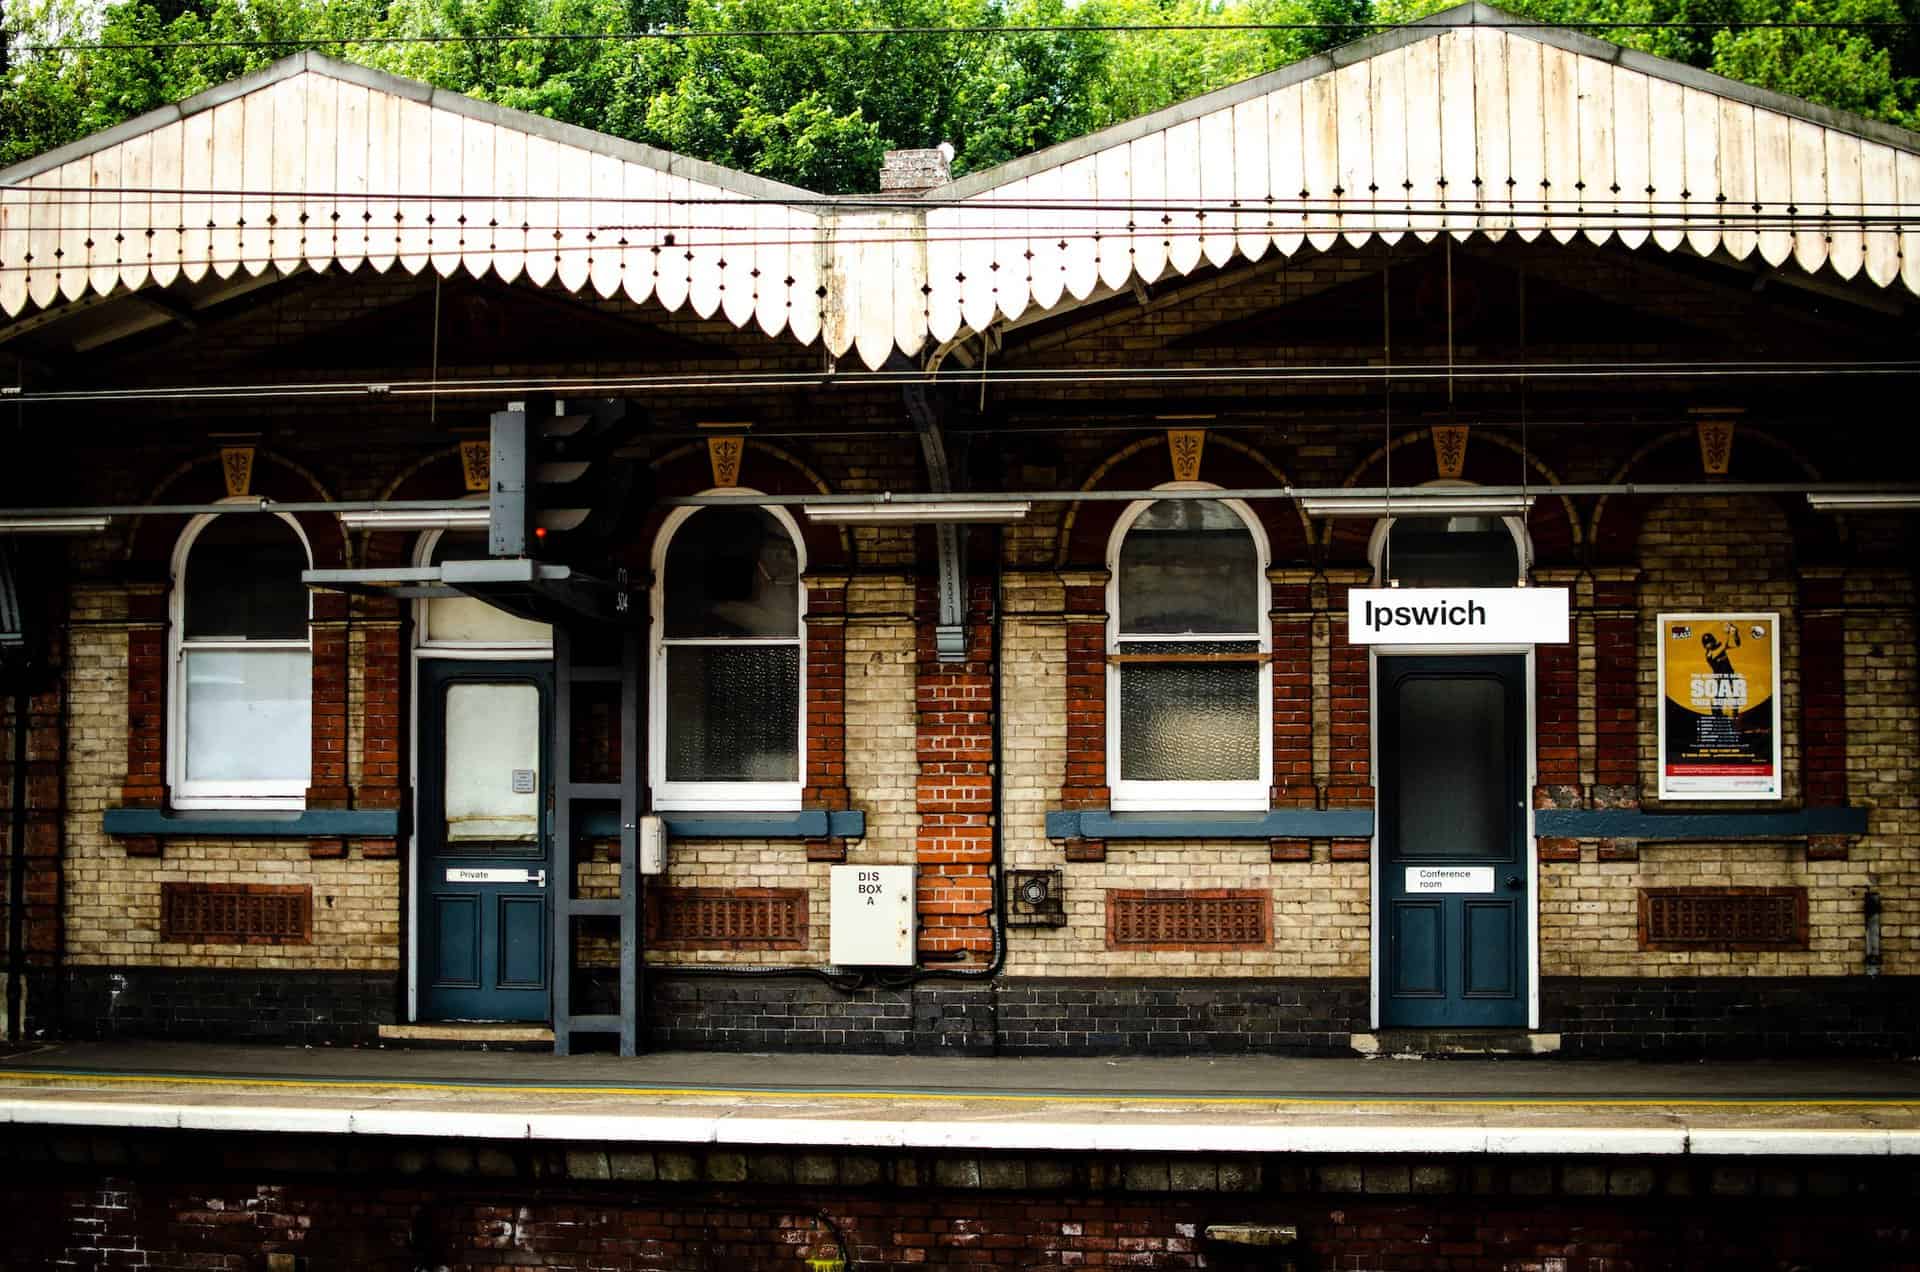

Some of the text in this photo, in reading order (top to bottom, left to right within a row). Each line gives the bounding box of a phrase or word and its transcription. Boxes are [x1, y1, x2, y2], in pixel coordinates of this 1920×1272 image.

[1365, 600, 1486, 632] Ipswich
[1690, 679, 1747, 698] SOAR
[460, 871, 488, 879] Private
[858, 872, 880, 882] DIS
[1419, 870, 1471, 878] Conference
[1419, 880, 1442, 888] room
[858, 885, 883, 895] BOX
[867, 896, 875, 905] A
